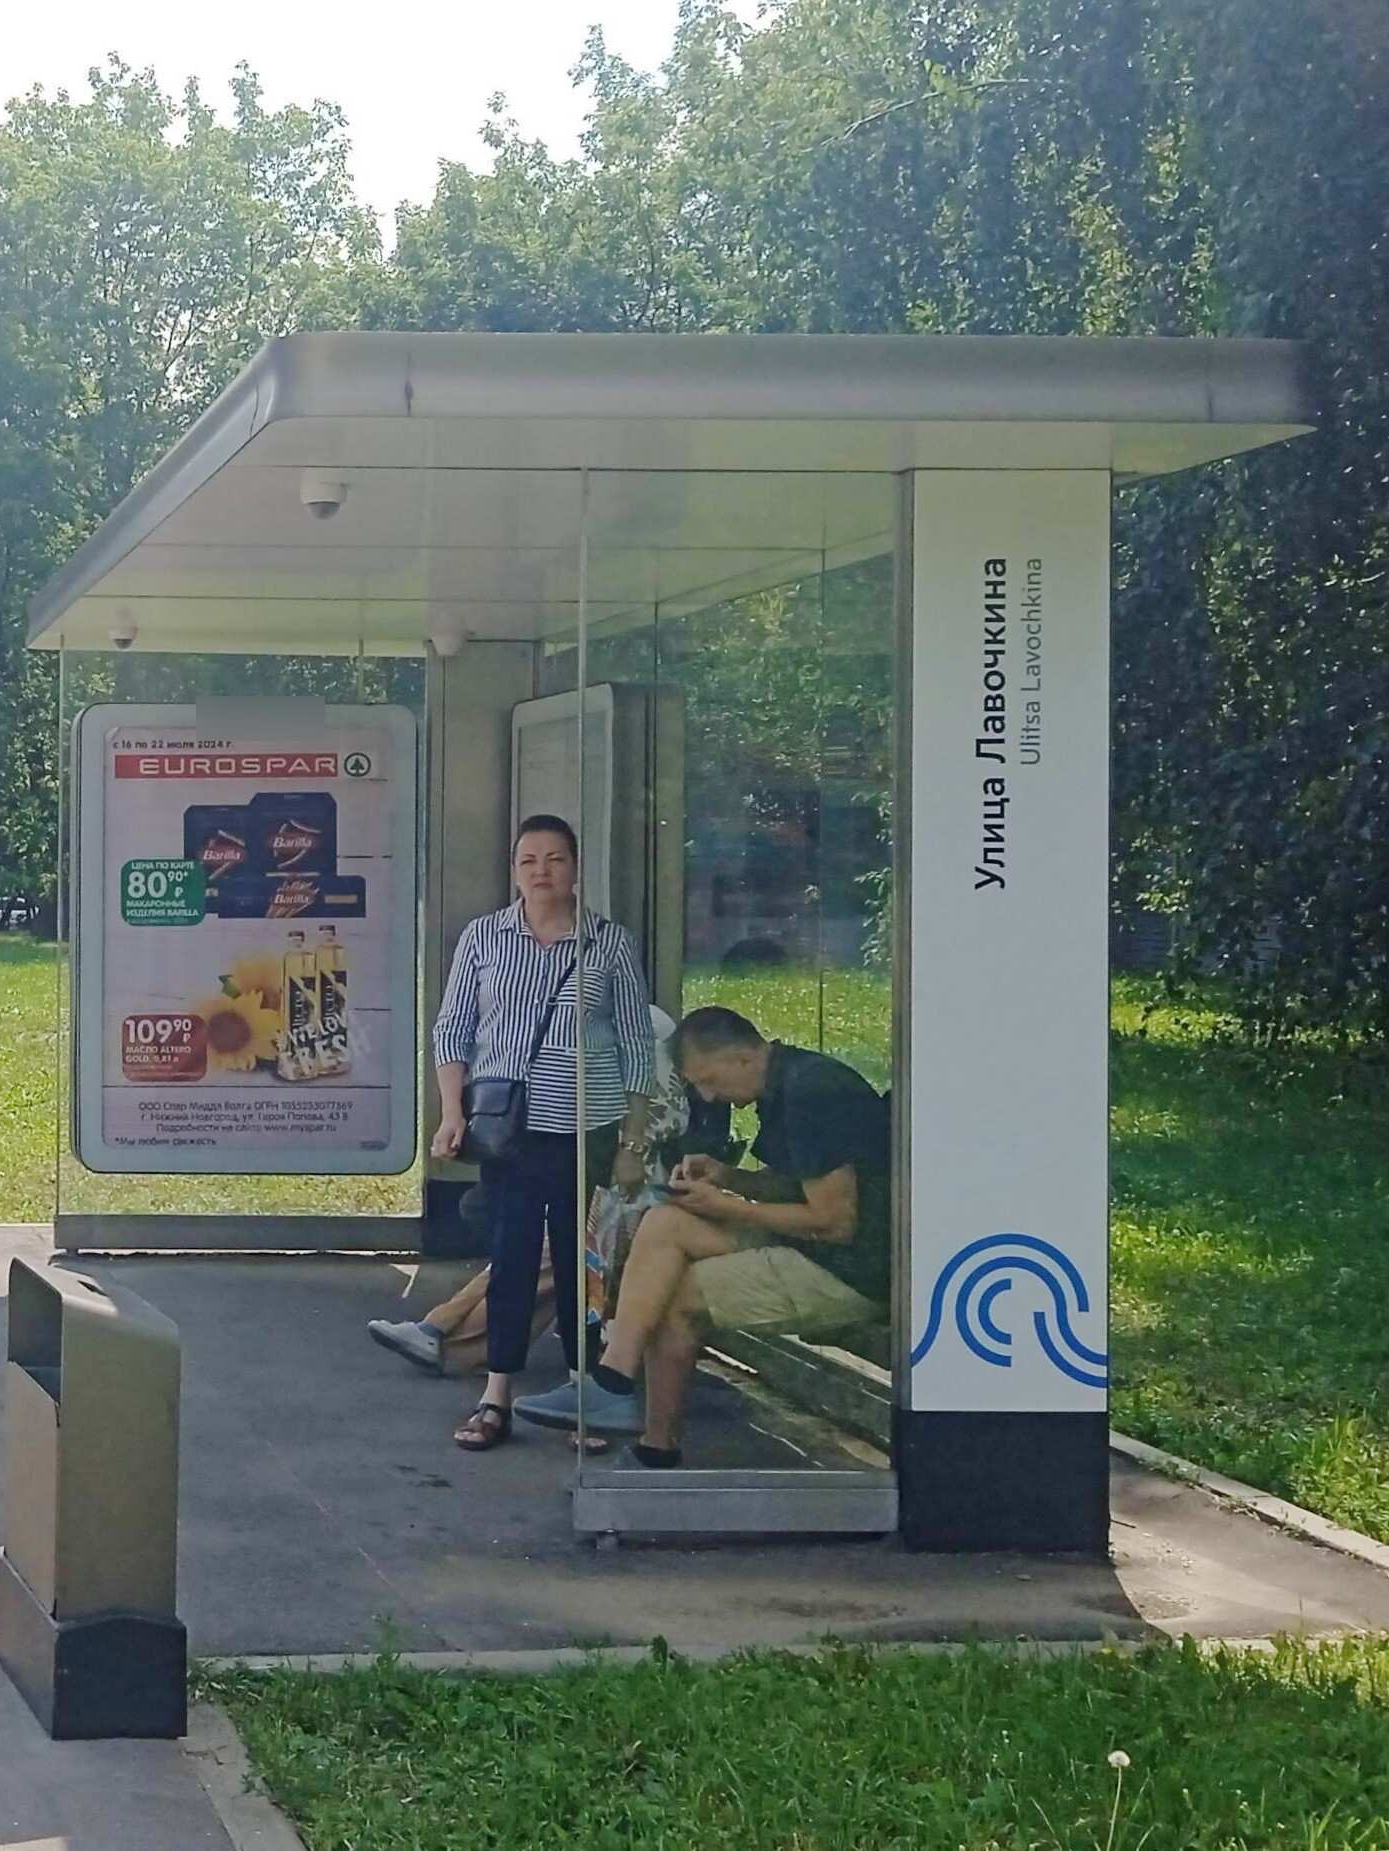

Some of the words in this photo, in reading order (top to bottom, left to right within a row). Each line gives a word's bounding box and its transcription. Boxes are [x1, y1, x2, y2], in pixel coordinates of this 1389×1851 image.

[1020, 557, 1042, 692] Lavochkina
[975, 557, 1007, 764] Лавочкина
[1020, 701, 1042, 765] Ulitsa
[122, 740, 132, 749] 16
[151, 740, 164, 749] 22
[167, 741, 195, 749] июля
[197, 740, 223, 749] 2024
[139, 757, 336, 774] EUROSPAR
[272, 836, 312, 849] Barilla
[975, 777, 1010, 890] Улица
[156, 861, 169, 869] ПО
[203, 849, 241, 860] Barilla
[127, 871, 168, 899] 80
[125, 1019, 173, 1044] 109
[173, 1018, 192, 1032] 90
[139, 1102, 161, 1111] ООО
[163, 1102, 187, 1112] Спар
